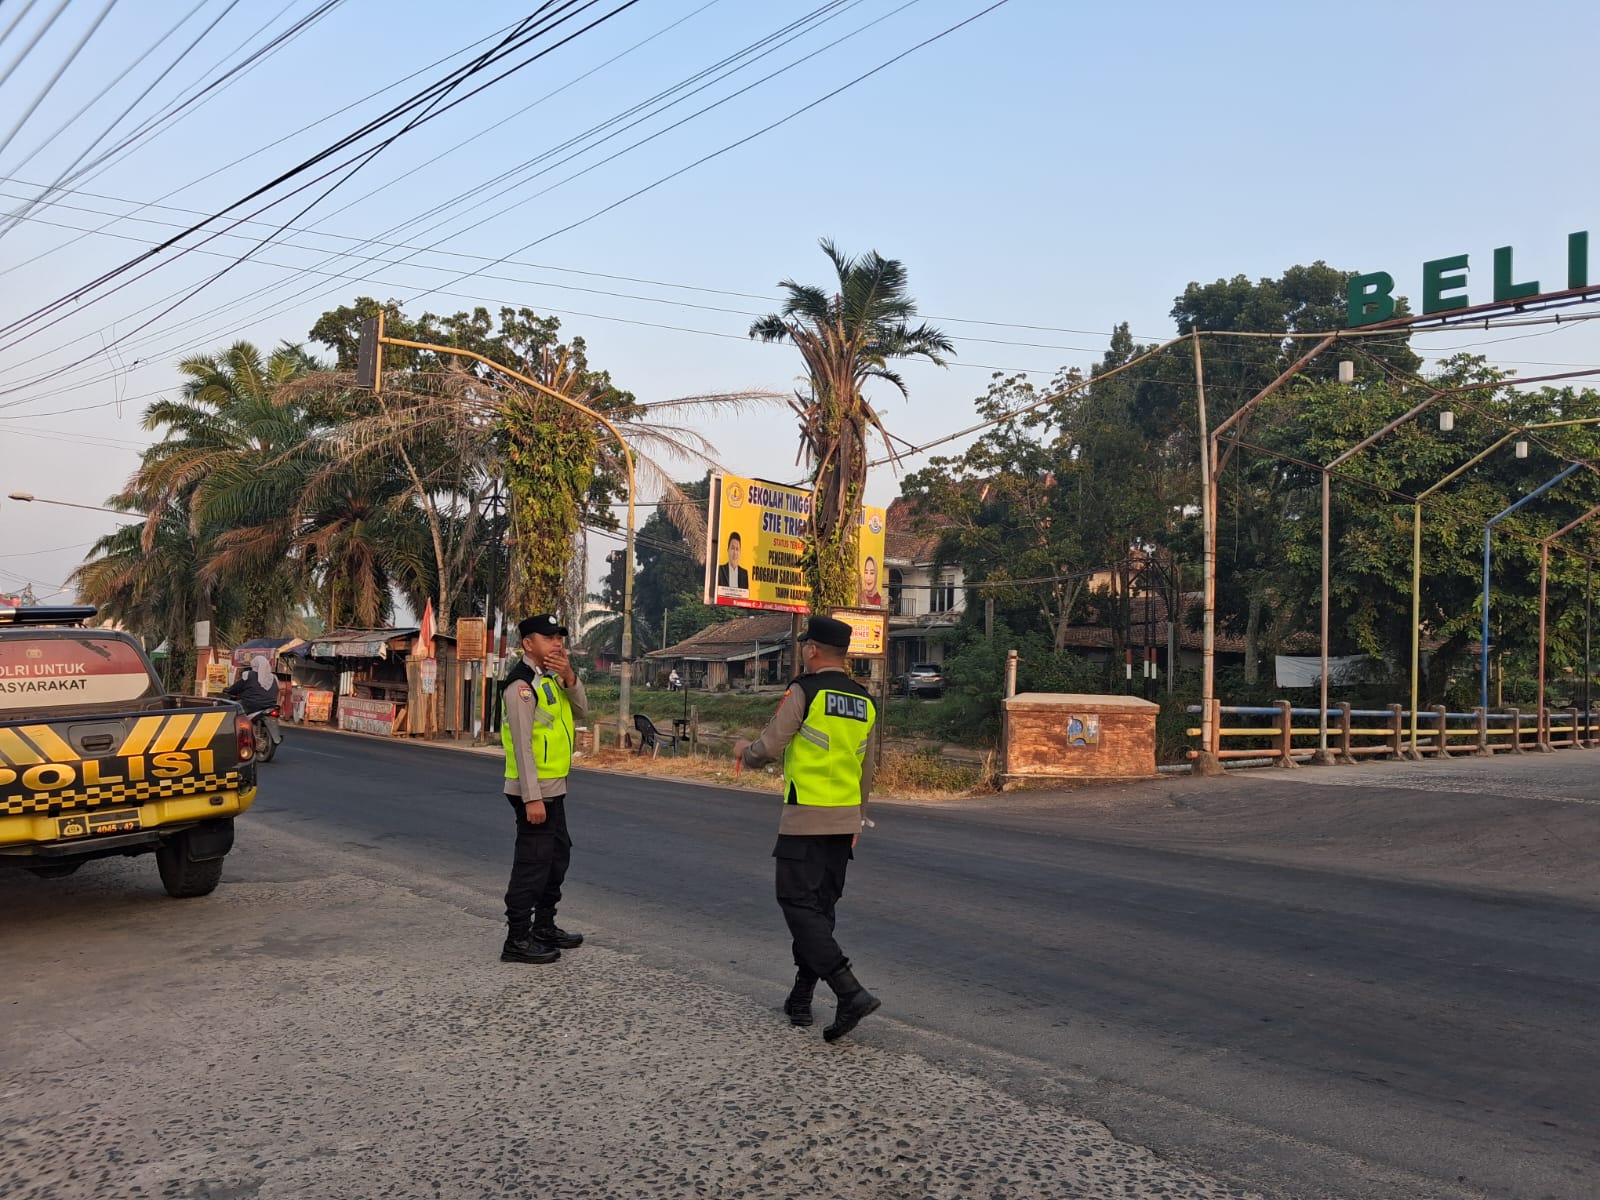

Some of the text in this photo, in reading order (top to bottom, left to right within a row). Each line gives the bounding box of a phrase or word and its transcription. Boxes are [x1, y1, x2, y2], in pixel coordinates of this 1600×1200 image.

[1348, 230, 1588, 328] BELI
[748, 485, 784, 510] SEKOLAH
[762, 512, 782, 534] STIE
[773, 538, 789, 548] STATUS
[752, 565, 778, 583] PROGRAM
[34, 663, 86, 676] UNTUK
[827, 693, 867, 720] POLISI
